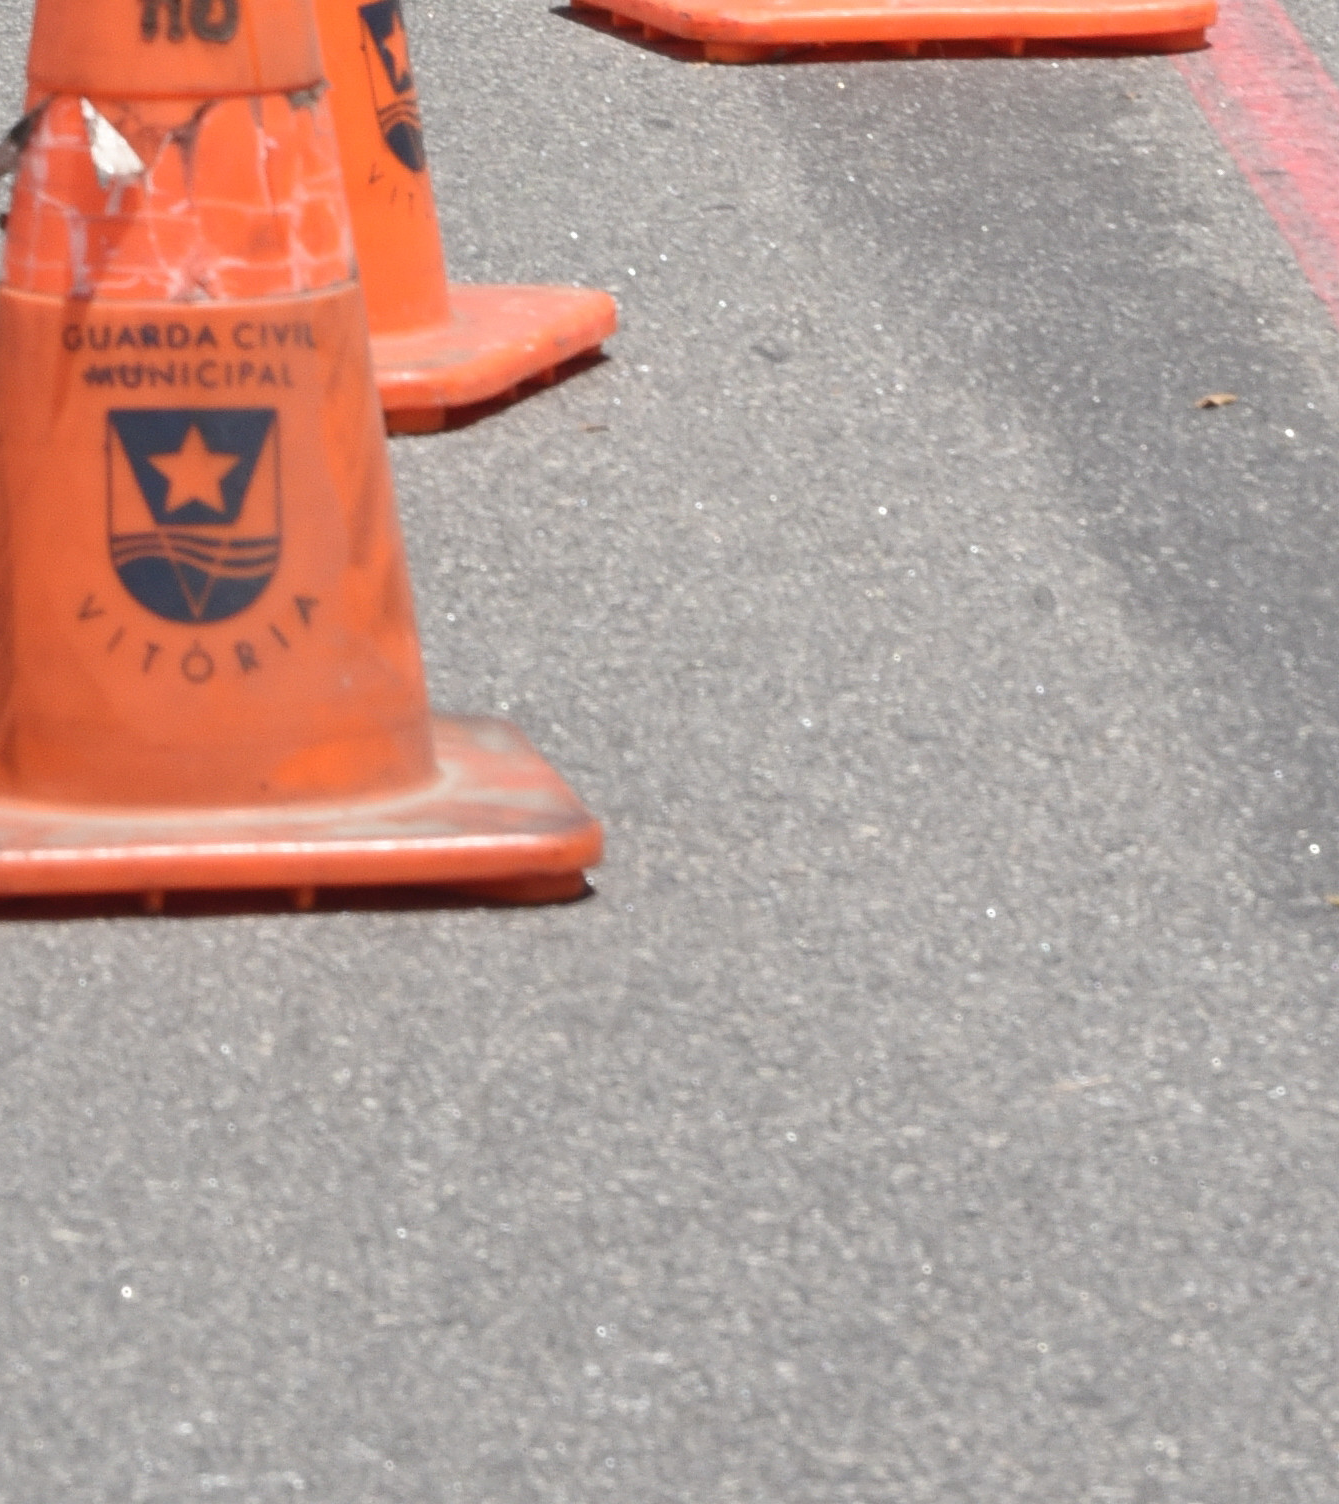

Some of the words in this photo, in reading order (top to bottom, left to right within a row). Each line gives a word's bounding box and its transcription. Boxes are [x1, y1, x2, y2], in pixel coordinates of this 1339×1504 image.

[62, 321, 218, 351] GUARDA
[233, 321, 317, 350] CIVIL
[82, 359, 295, 388] MUNICIPAL
[76, 593, 320, 685] VITÓRIA
